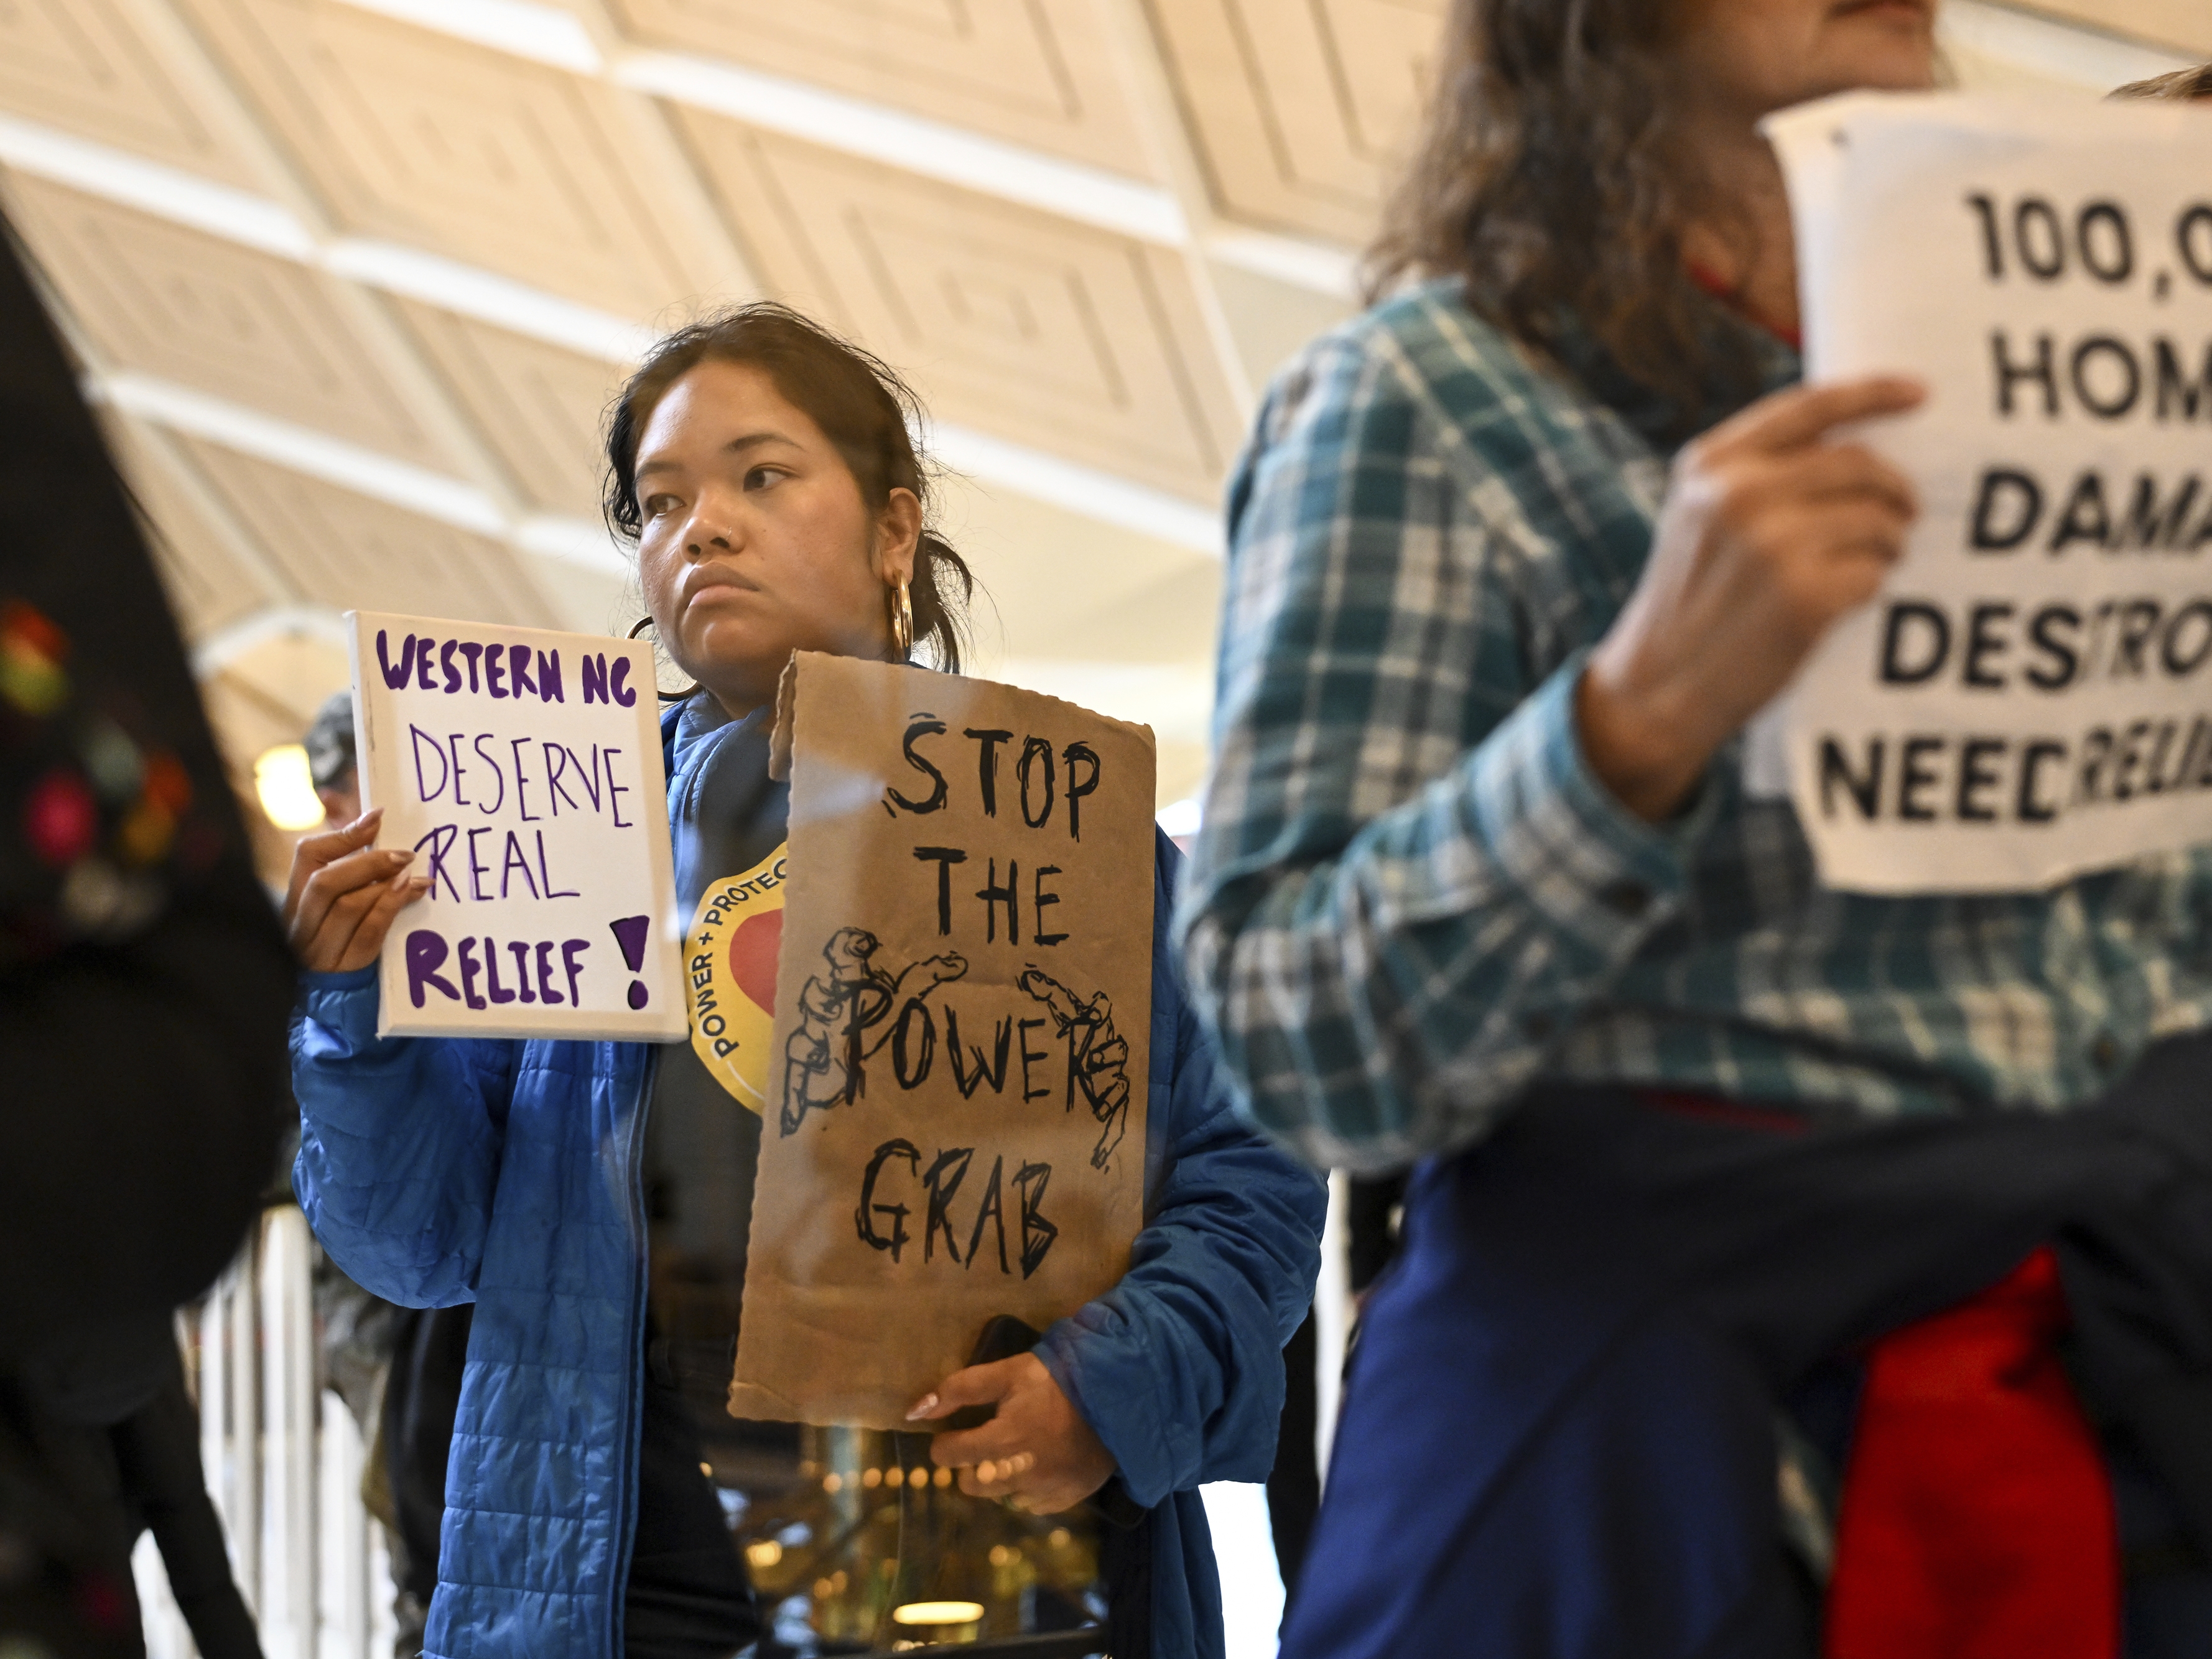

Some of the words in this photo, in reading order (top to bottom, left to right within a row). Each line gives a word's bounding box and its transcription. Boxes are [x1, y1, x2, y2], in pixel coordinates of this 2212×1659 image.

[376, 629, 565, 704] WESTERN
[409, 722, 633, 828] DESERVE
[882, 712, 1102, 843] STOP
[414, 824, 581, 903] REAL
[913, 846, 1070, 947] THE
[692, 952, 740, 1059] POWER
[842, 983, 1112, 1118] POWER
[855, 1138, 1058, 1280] GRAB
